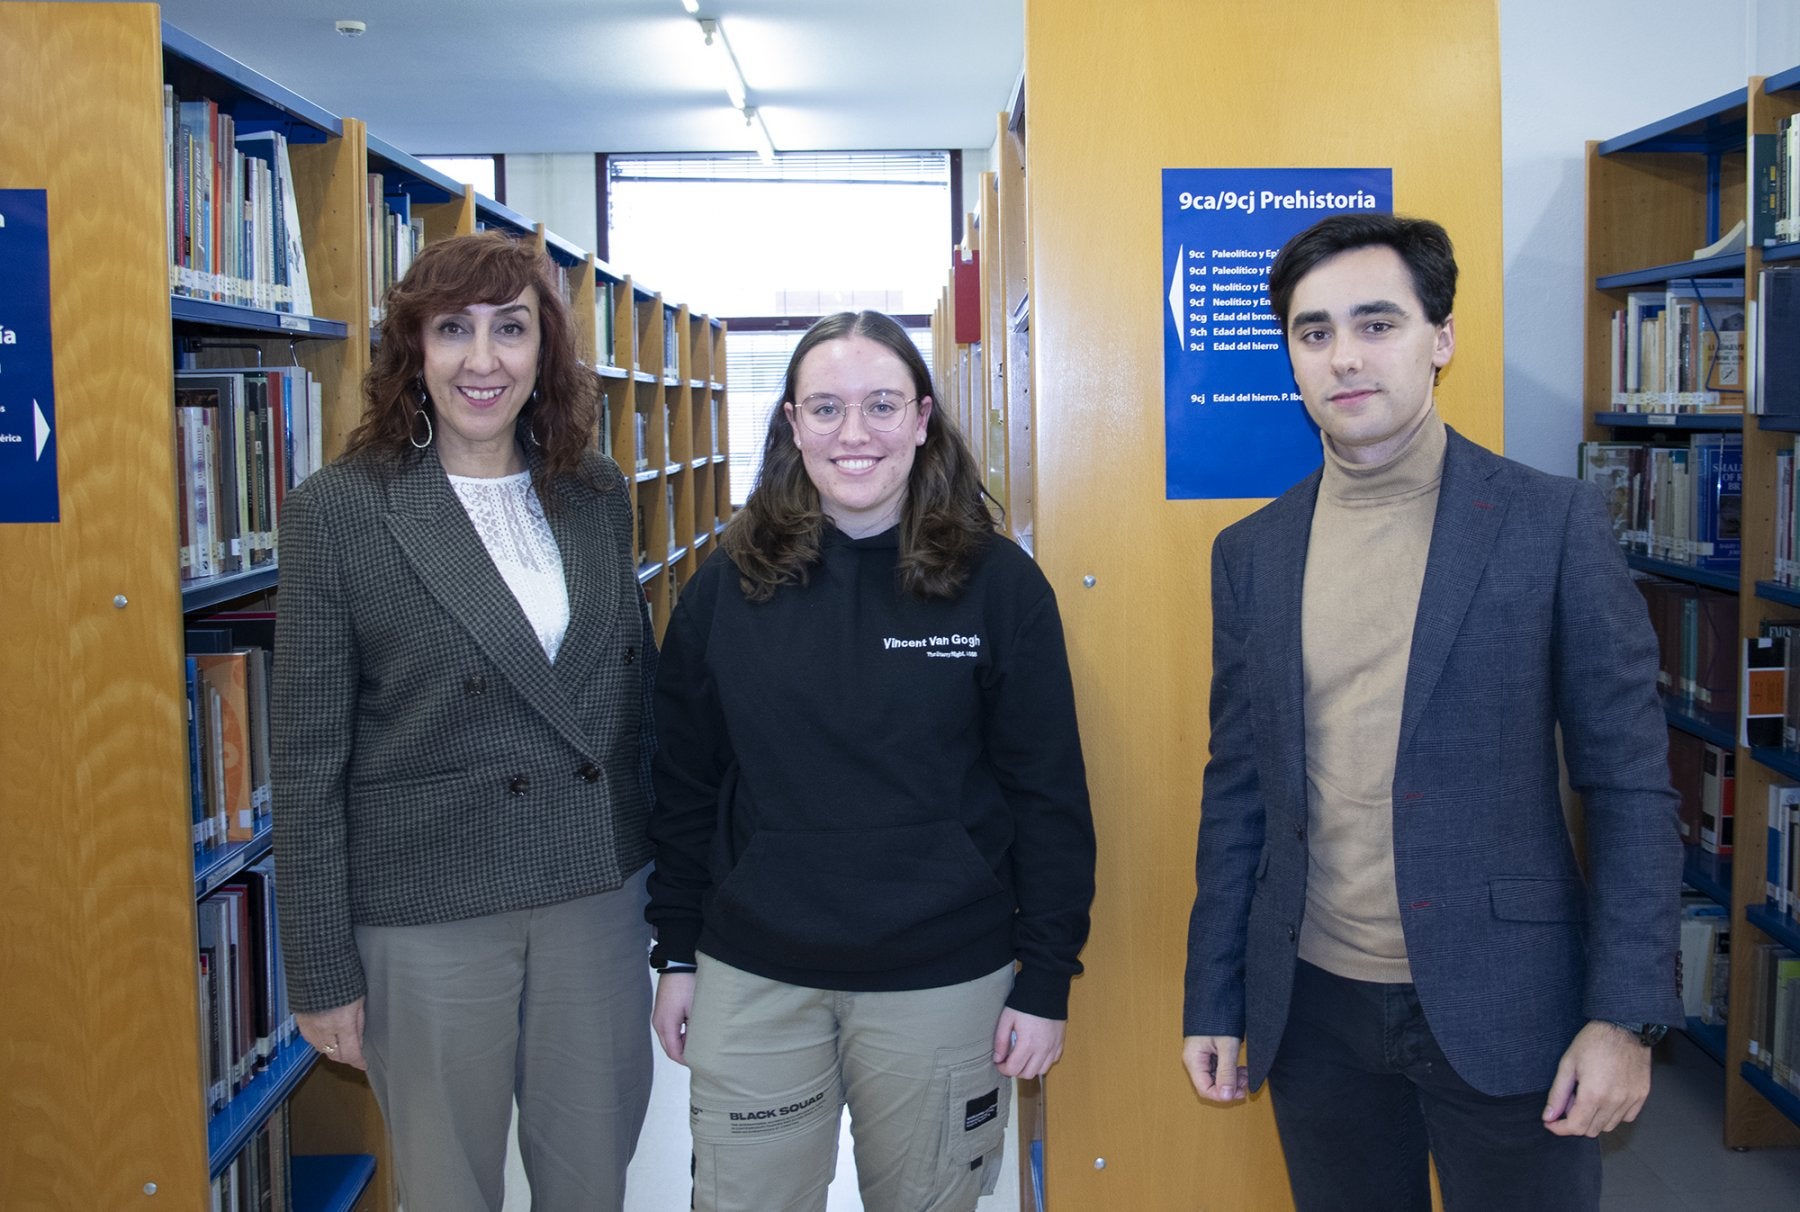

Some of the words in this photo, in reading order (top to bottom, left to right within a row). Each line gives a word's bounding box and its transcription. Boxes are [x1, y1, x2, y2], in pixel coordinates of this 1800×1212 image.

[1178, 191, 1255, 214] 9ca/9cj
[1260, 190, 1376, 209] Prehistoria
[1189, 250, 1205, 259] 9cc
[1212, 249, 1257, 258] Paleolítico
[1259, 251, 1264, 259] y
[1266, 249, 1279, 259] Ep
[1189, 266, 1206, 275] 9cd
[1212, 266, 1258, 275] Paleolítico
[1259, 267, 1264, 276] y
[1266, 266, 1272, 275] E
[1189, 283, 1206, 292] 9ce
[1212, 282, 1251, 292] Neolítico
[1253, 285, 1258, 293] y
[1189, 298, 1205, 307] 9cf
[1212, 298, 1251, 306] Neolítico
[1253, 299, 1259, 307] y
[1260, 298, 1271, 306] En
[1189, 313, 1207, 323] 9cg
[1213, 312, 1235, 321] Edad
[1236, 312, 1250, 321] del
[1190, 328, 1207, 336] 9ch
[1213, 327, 1235, 336] Edad
[1236, 327, 1250, 335] del
[1190, 342, 1205, 351] 9ci
[1213, 342, 1235, 351] Edad
[1237, 342, 1250, 350] del
[1252, 341, 1279, 350] hierro
[1190, 394, 1206, 405] 9cj
[1213, 393, 1235, 402] Edad
[1236, 393, 1250, 402] del
[1252, 393, 1280, 402] hierro.
[1281, 393, 1289, 401] P.
[0, 434, 22, 443] érica
[883, 637, 927, 649] Vincent
[929, 636, 949, 646] Van
[951, 634, 980, 648] Gogh
[729, 1109, 776, 1121] BLACK
